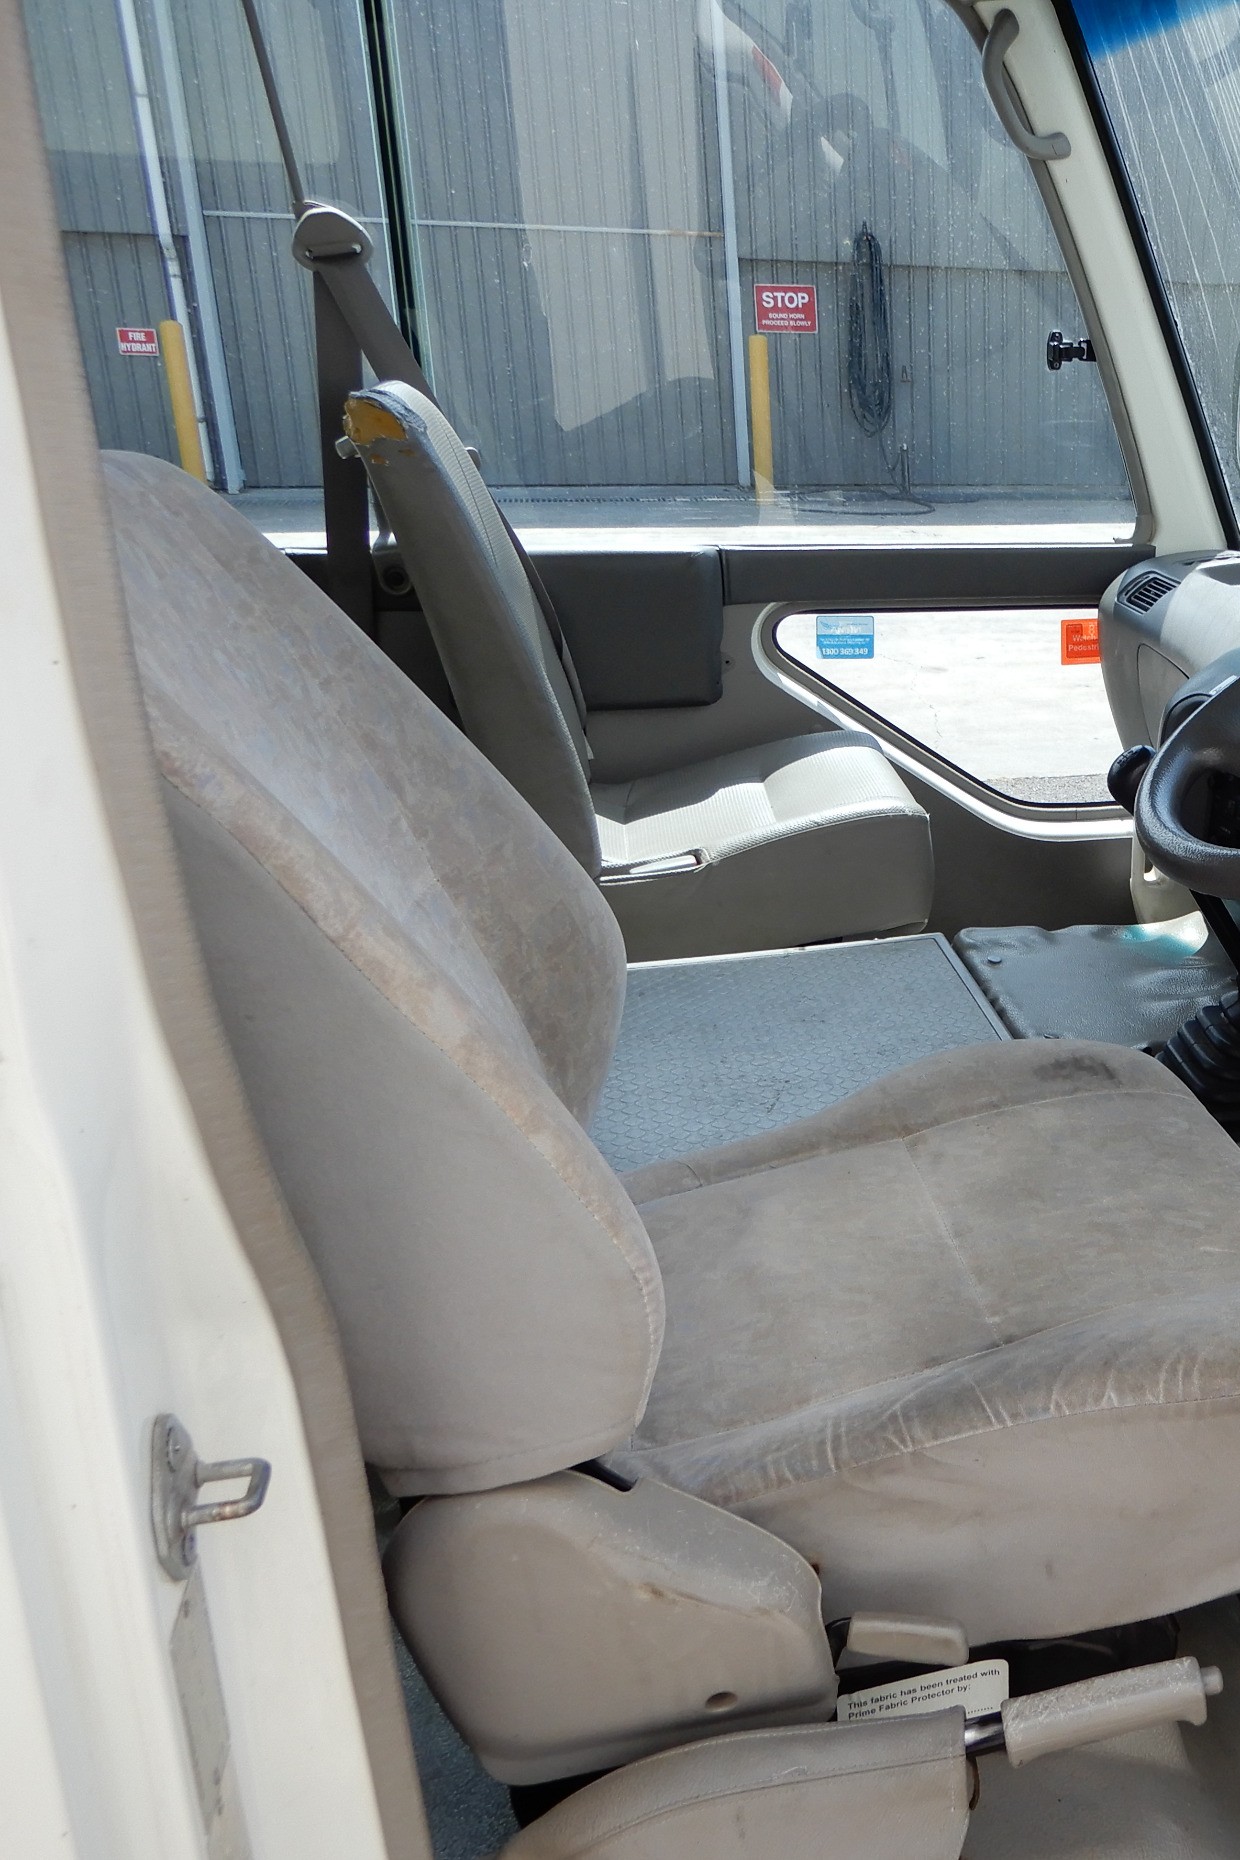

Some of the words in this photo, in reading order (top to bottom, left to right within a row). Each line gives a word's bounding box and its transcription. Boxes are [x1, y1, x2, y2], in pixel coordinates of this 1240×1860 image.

[761, 291, 810, 308] STOP
[128, 331, 146, 341] FIRE
[120, 343, 156, 352] HYDRANT
[1072, 634, 1097, 642] Watch
[822, 647, 839, 656] 1300
[1068, 643, 1100, 652] Pedestri
[848, 1700, 868, 1710] This
[871, 1692, 897, 1704] fabric
[900, 1688, 917, 1697] has
[920, 1681, 943, 1692] been
[946, 1672, 978, 1685] treated
[980, 1669, 1000, 1677] with
[848, 1708, 876, 1720] Prime
[879, 1699, 908, 1712] Fabric
[911, 1686, 955, 1703] Protector
[957, 1683, 971, 1693] by:
